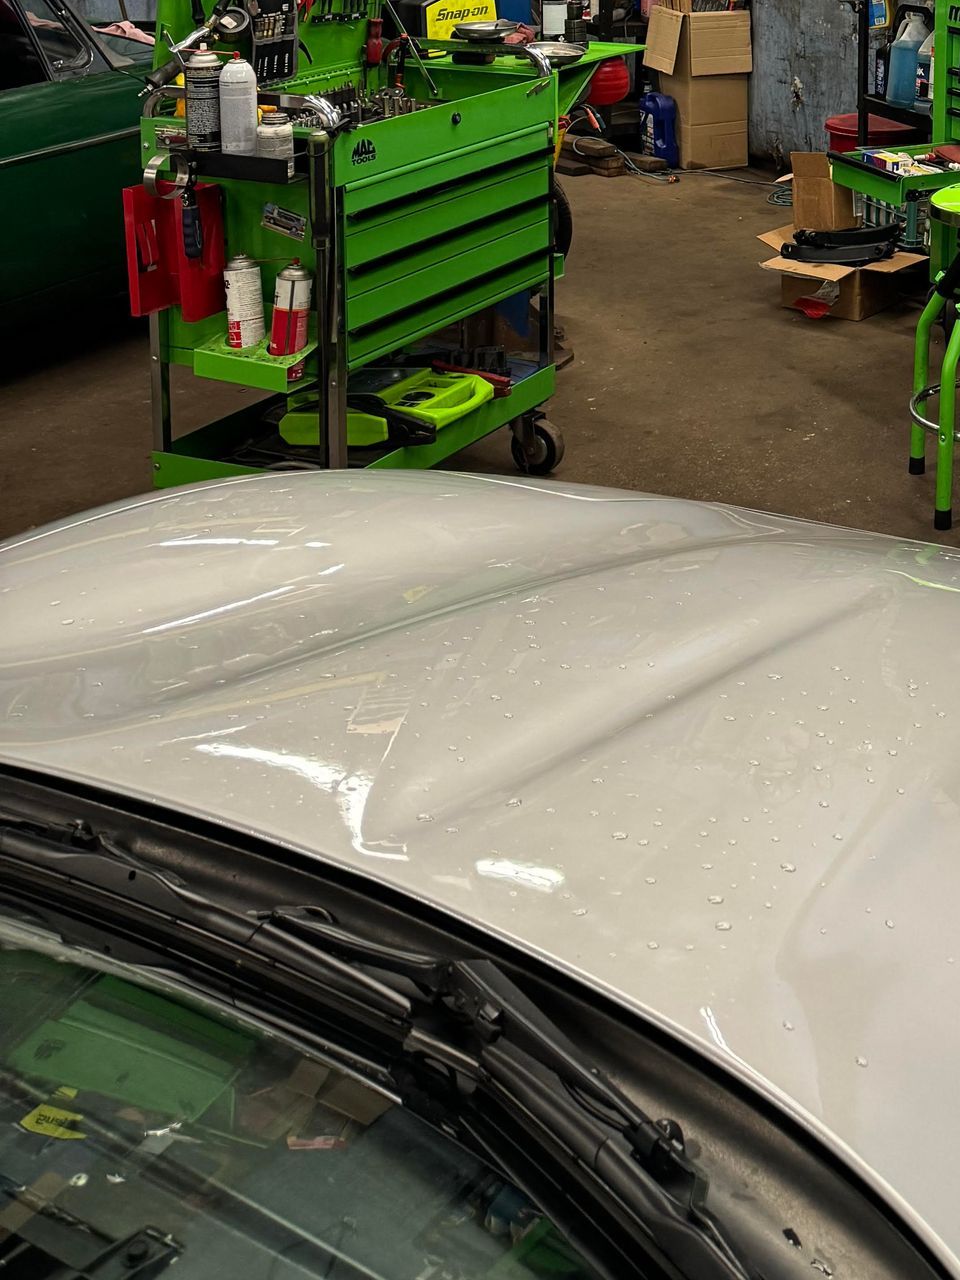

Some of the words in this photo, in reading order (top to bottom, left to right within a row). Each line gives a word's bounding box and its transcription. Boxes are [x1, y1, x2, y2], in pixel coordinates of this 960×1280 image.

[435, 5, 489, 22] Snap-on
[352, 138, 376, 158] MAC
[352, 153, 377, 166] TOOLS
